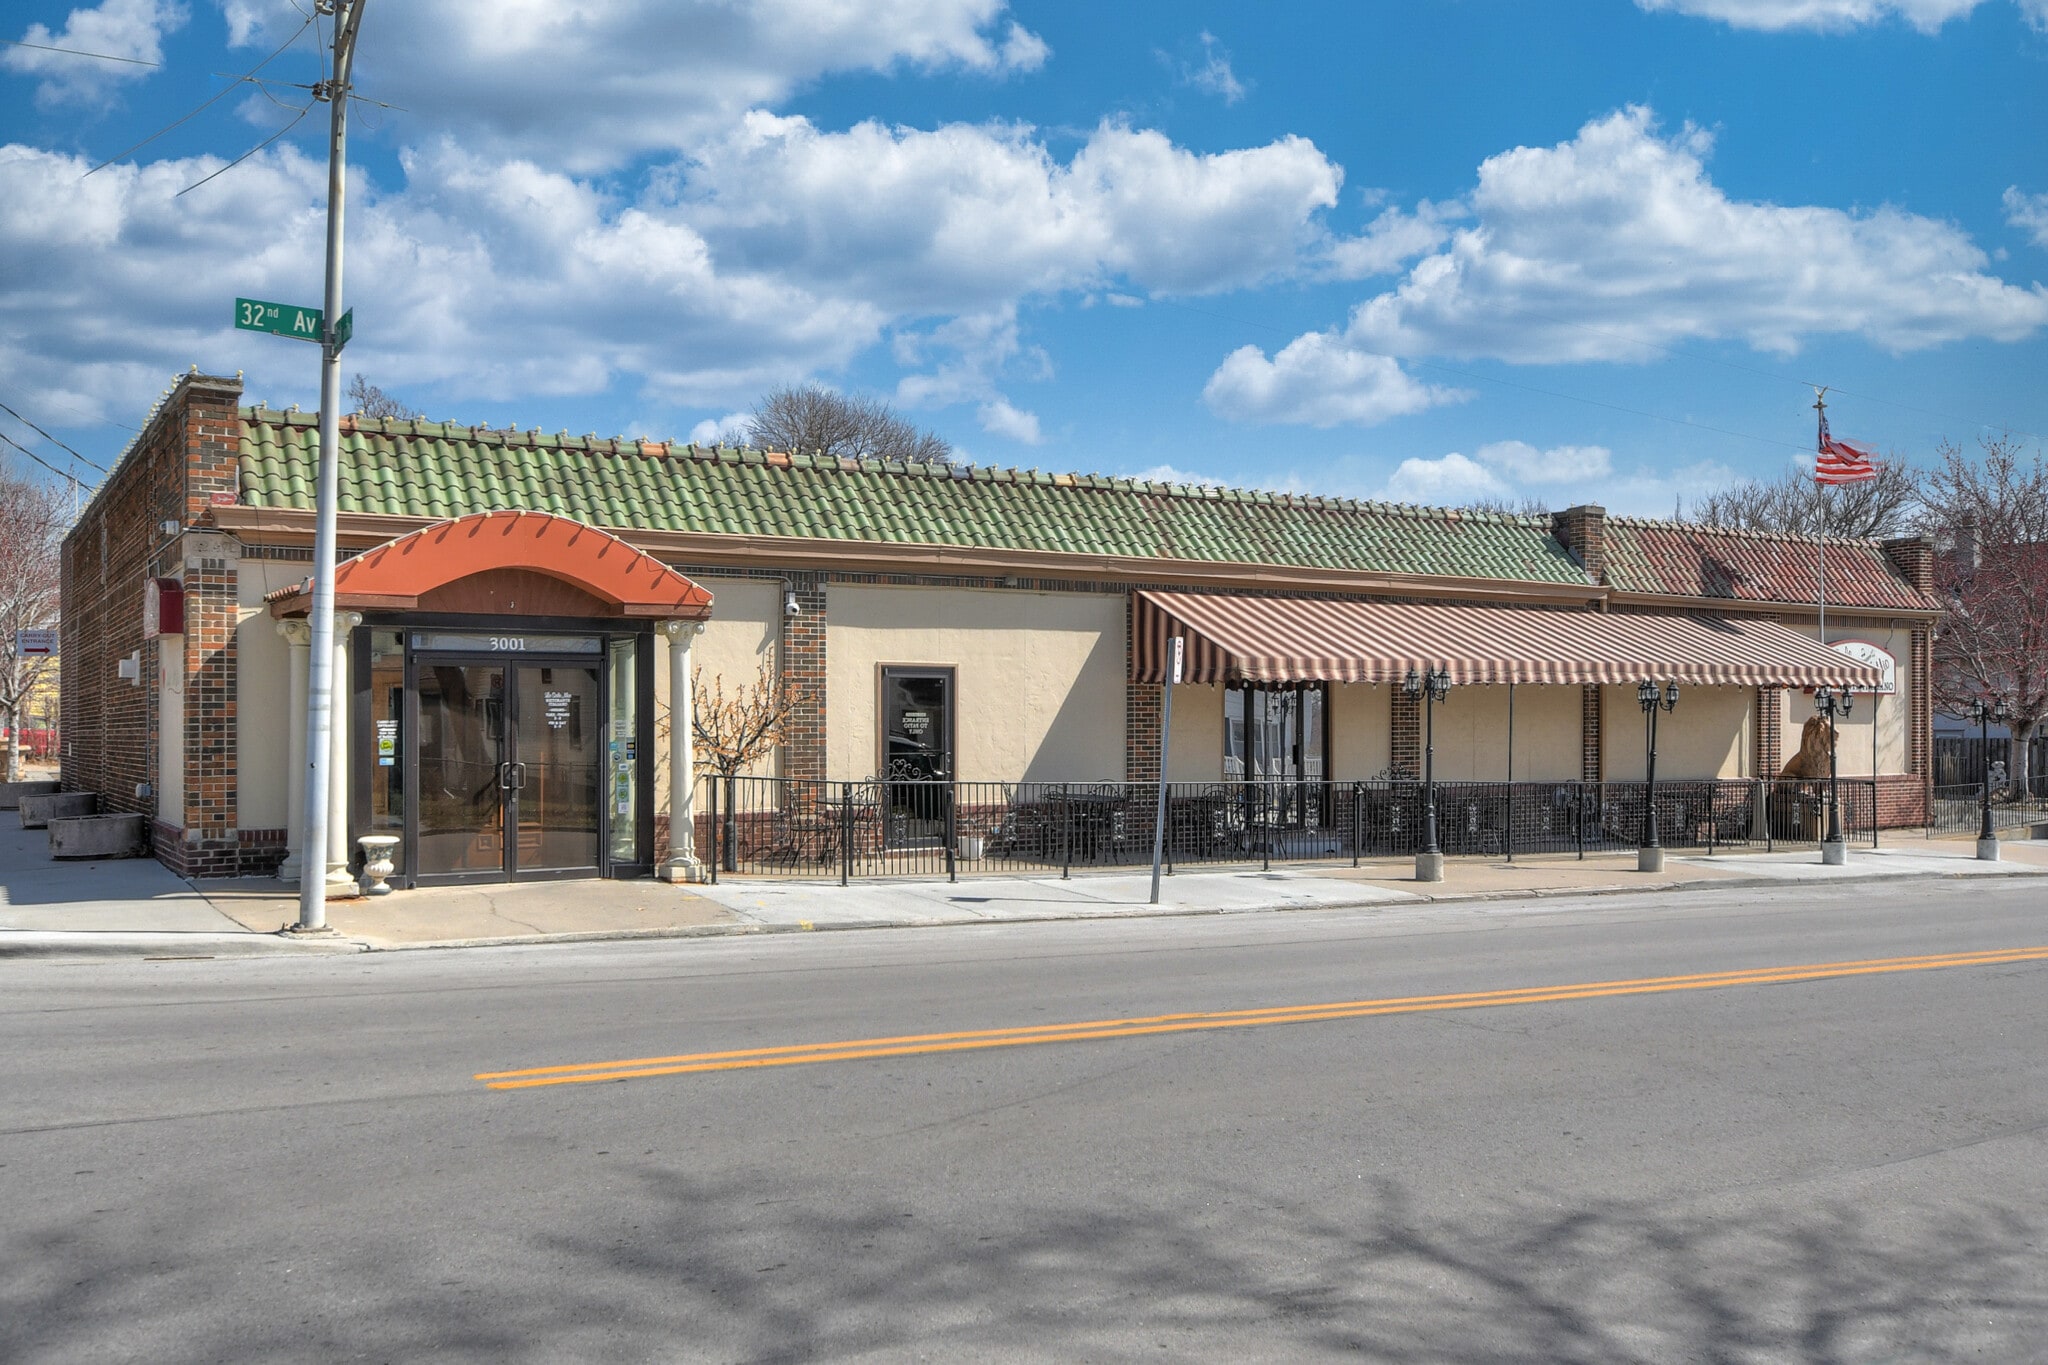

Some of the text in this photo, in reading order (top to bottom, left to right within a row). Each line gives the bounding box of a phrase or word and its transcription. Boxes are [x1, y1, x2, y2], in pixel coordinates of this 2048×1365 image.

[241, 302, 316, 333] 32nd Av
[489, 637, 526, 651] 3001
